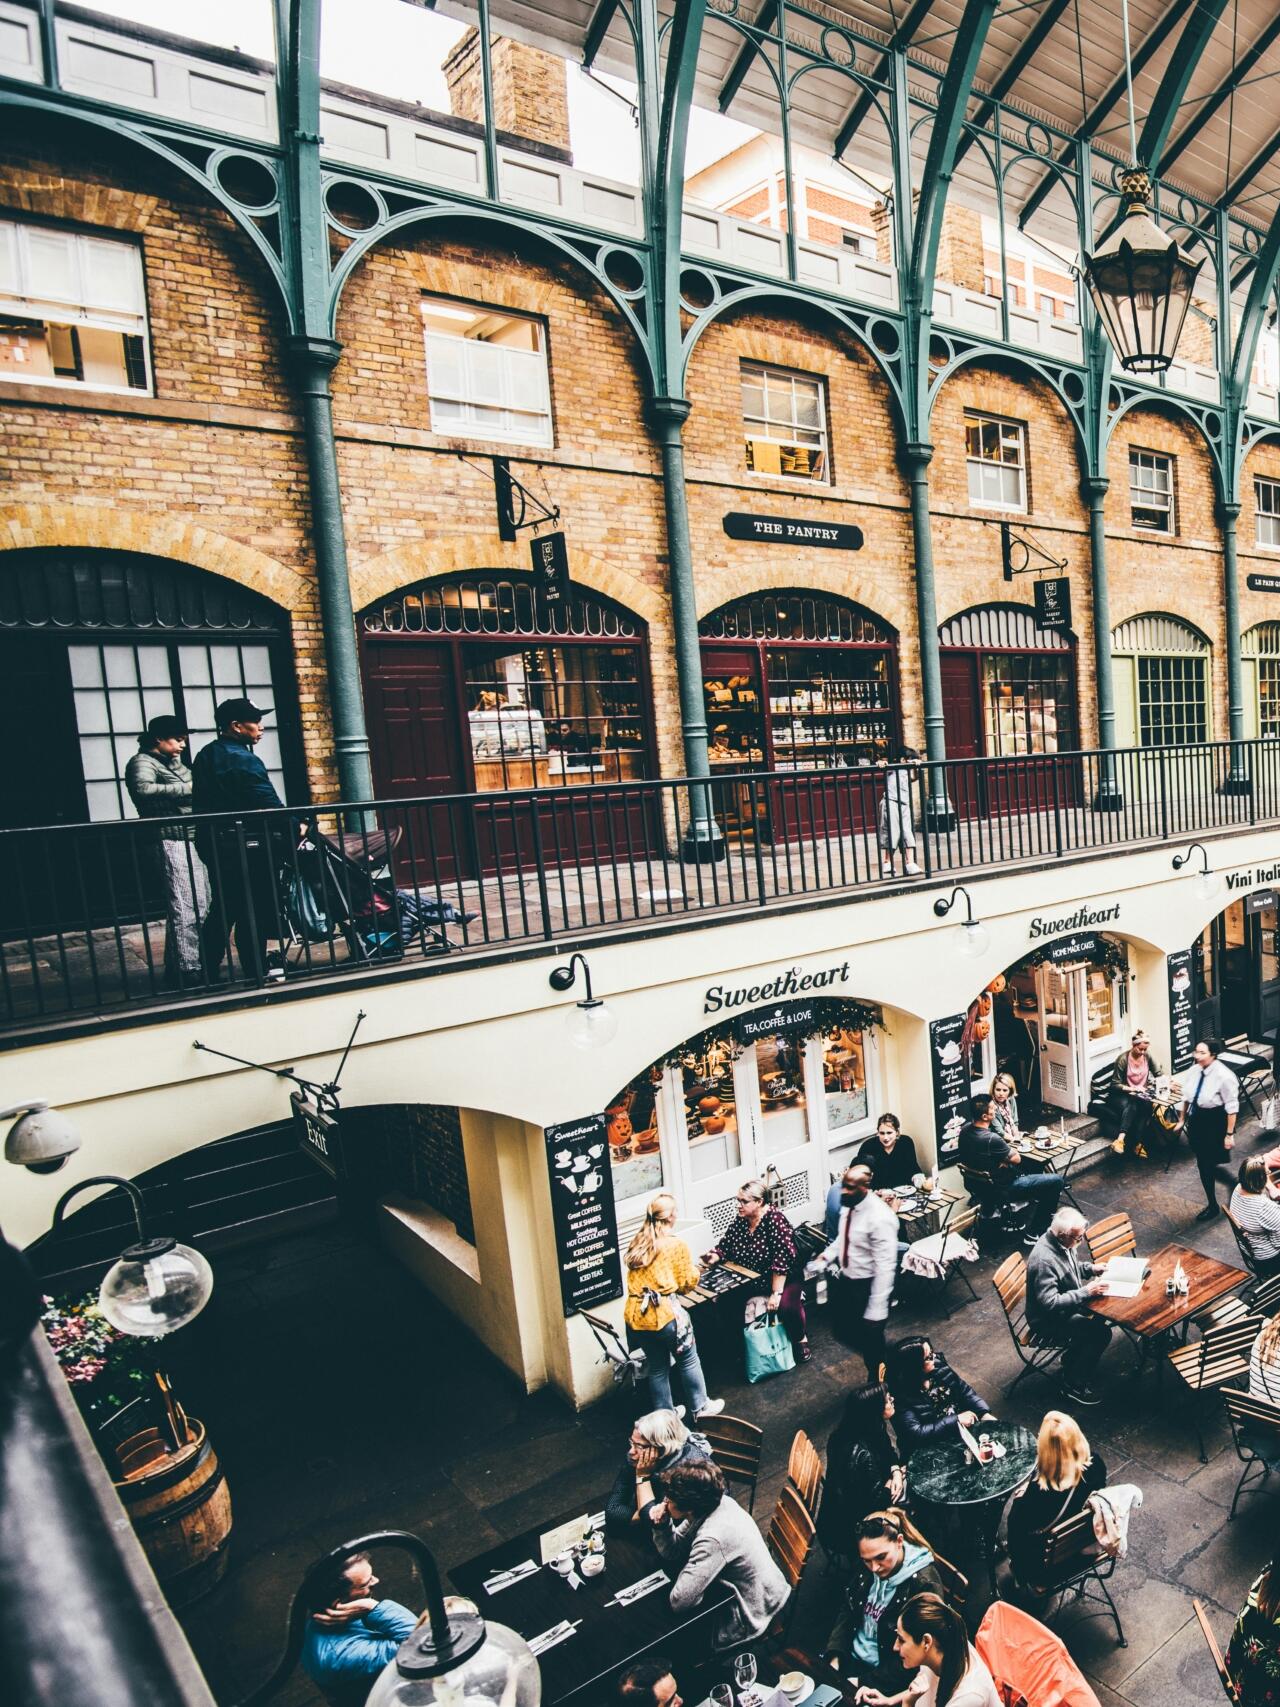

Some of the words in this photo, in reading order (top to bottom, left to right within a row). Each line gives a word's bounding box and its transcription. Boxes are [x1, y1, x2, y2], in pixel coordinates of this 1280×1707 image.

[753, 521, 783, 534] THE
[787, 525, 839, 540] PANTRY
[1225, 869, 1252, 889] Vini
[1029, 903, 1121, 939] Sweetheart
[1053, 946, 1068, 958] HOME
[1068, 943, 1080, 954] MADE
[1080, 940, 1095, 951] CAKES
[703, 961, 850, 1015] Sweetheart
[786, 1014, 792, 1024] &
[793, 1009, 812, 1023] LOVE
[305, 1117, 329, 1156] Exit
[554, 1123, 599, 1143] Sweetheart
[567, 1211, 581, 1220] Great
[581, 1204, 602, 1216] COFFEES
[570, 1220, 583, 1230] MILK
[582, 1214, 602, 1227] SHAKES
[566, 1238, 577, 1248] HOT
[577, 1228, 608, 1244] CHOCOLATES
[573, 1248, 584, 1257] ICED
[584, 1241, 604, 1254] COFFEES
[602, 1247, 616, 1257] made
[579, 1272, 591, 1283] ICED
[591, 1268, 604, 1279] TEAS
